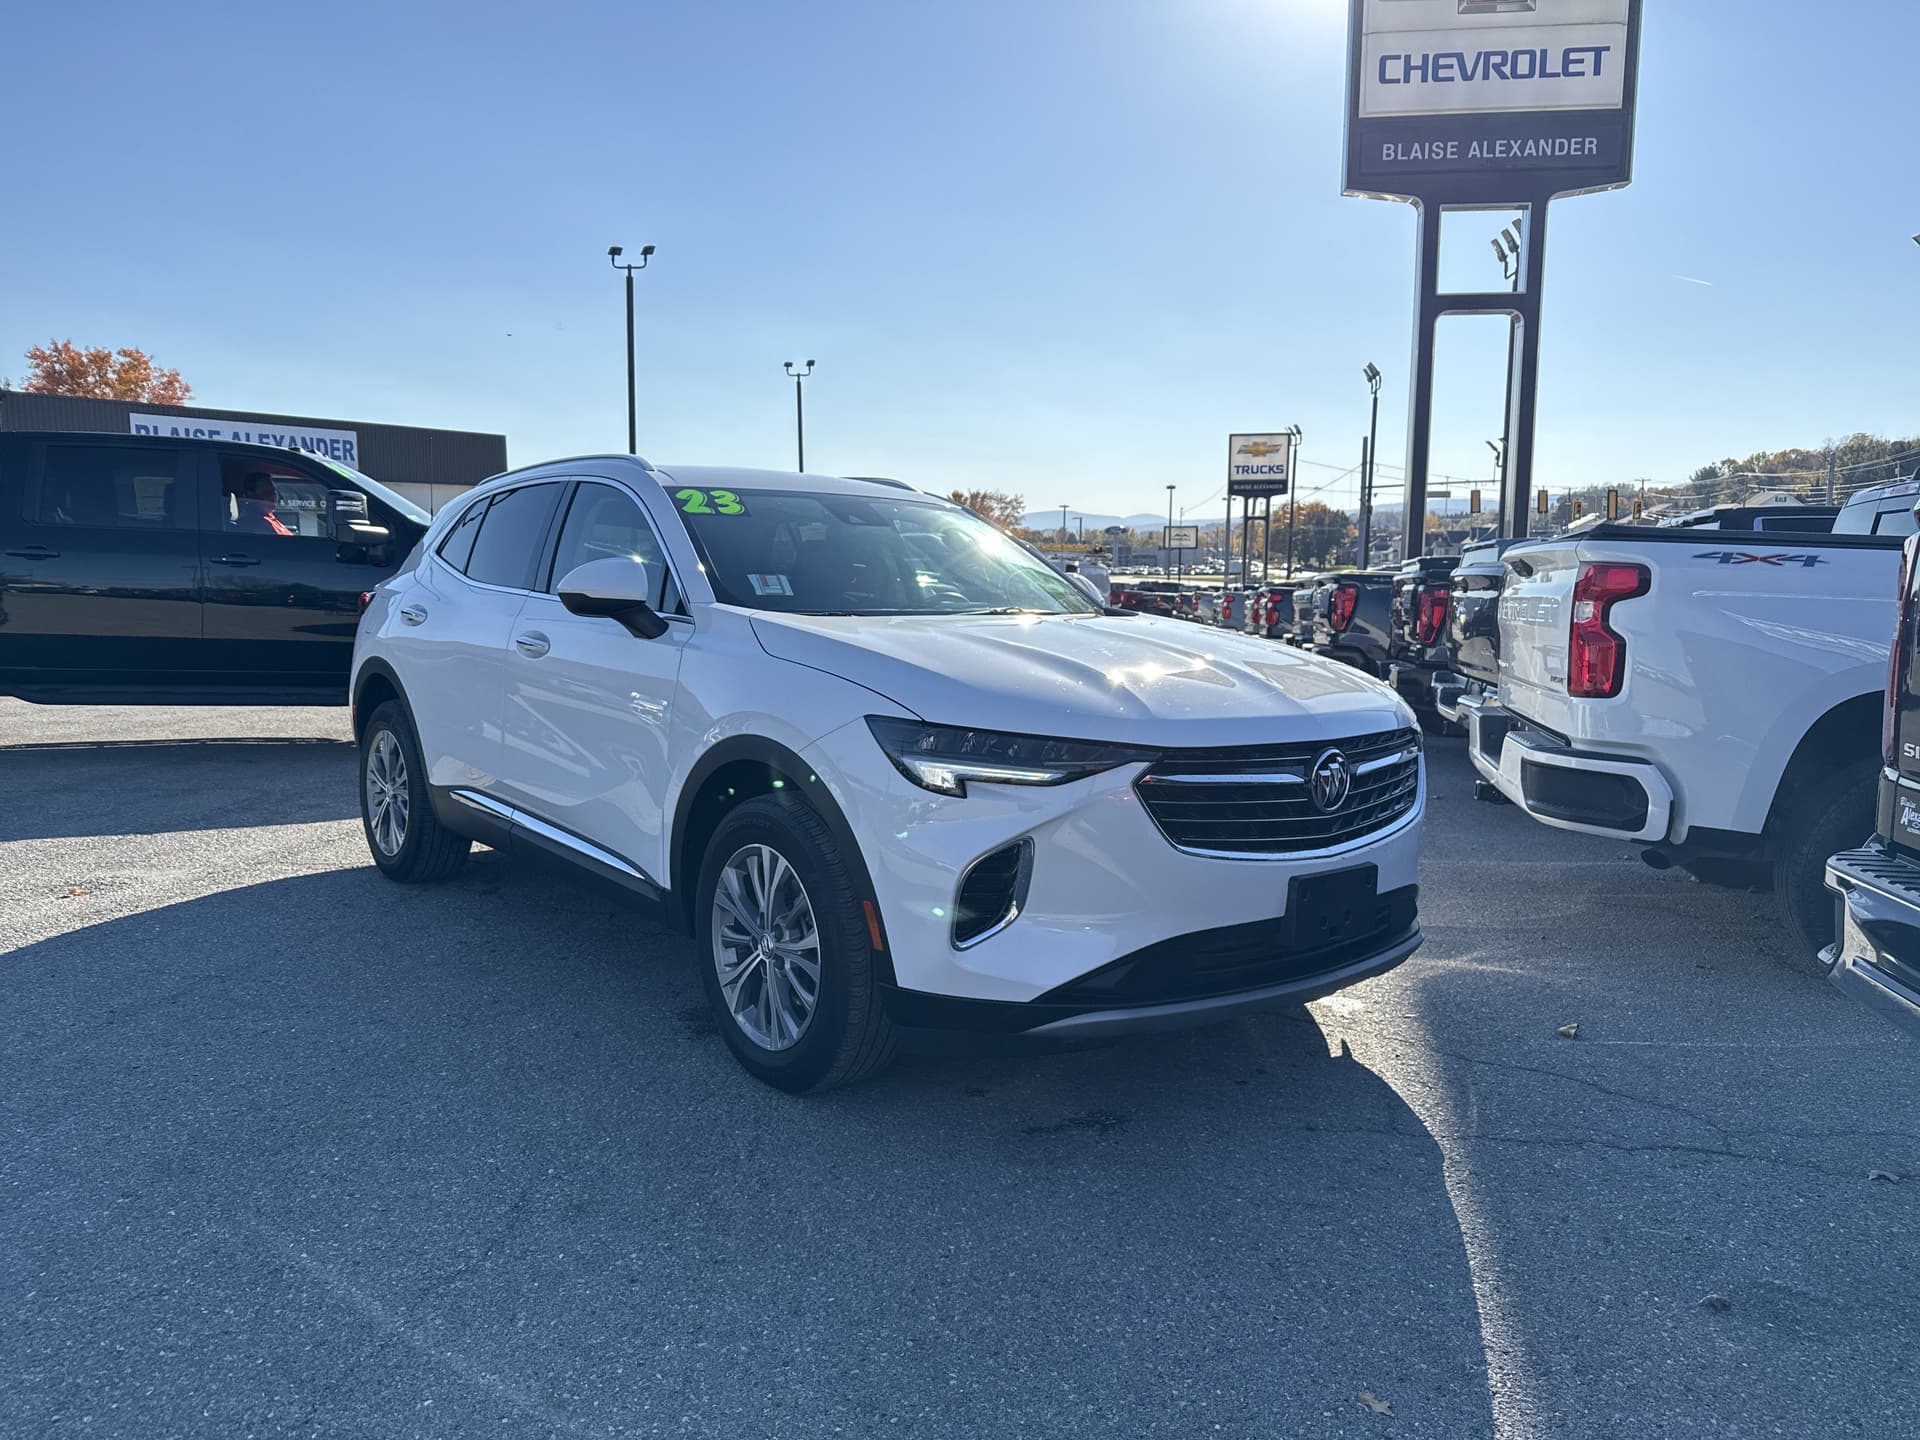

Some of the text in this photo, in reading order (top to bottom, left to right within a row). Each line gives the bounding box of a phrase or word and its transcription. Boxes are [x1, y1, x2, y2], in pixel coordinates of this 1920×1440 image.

[1378, 45, 1611, 85] CHEVROLET
[1382, 137, 1598, 161] BLAISE ALEXANDER
[1234, 464, 1285, 475] TRUCKS
[675, 488, 745, 515] 23
